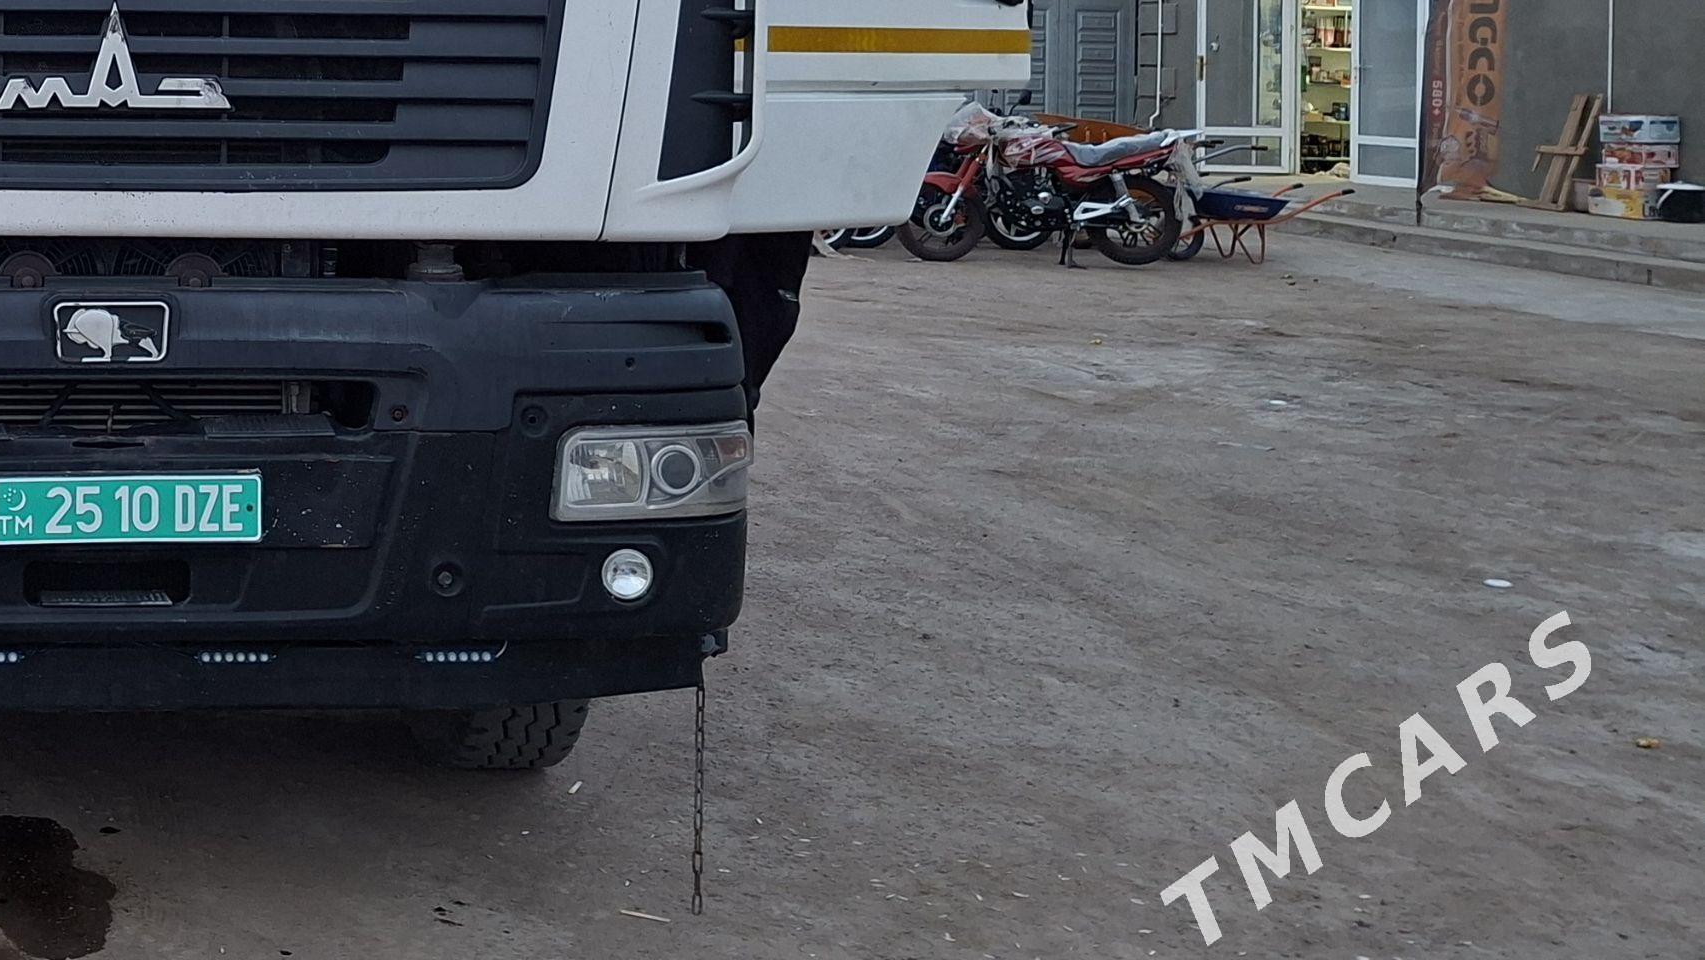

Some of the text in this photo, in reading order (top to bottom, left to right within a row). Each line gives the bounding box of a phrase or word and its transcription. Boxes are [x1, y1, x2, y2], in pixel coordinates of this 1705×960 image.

[45, 486, 102, 534] 25
[115, 485, 159, 532] 10
[175, 484, 243, 532] DZE
